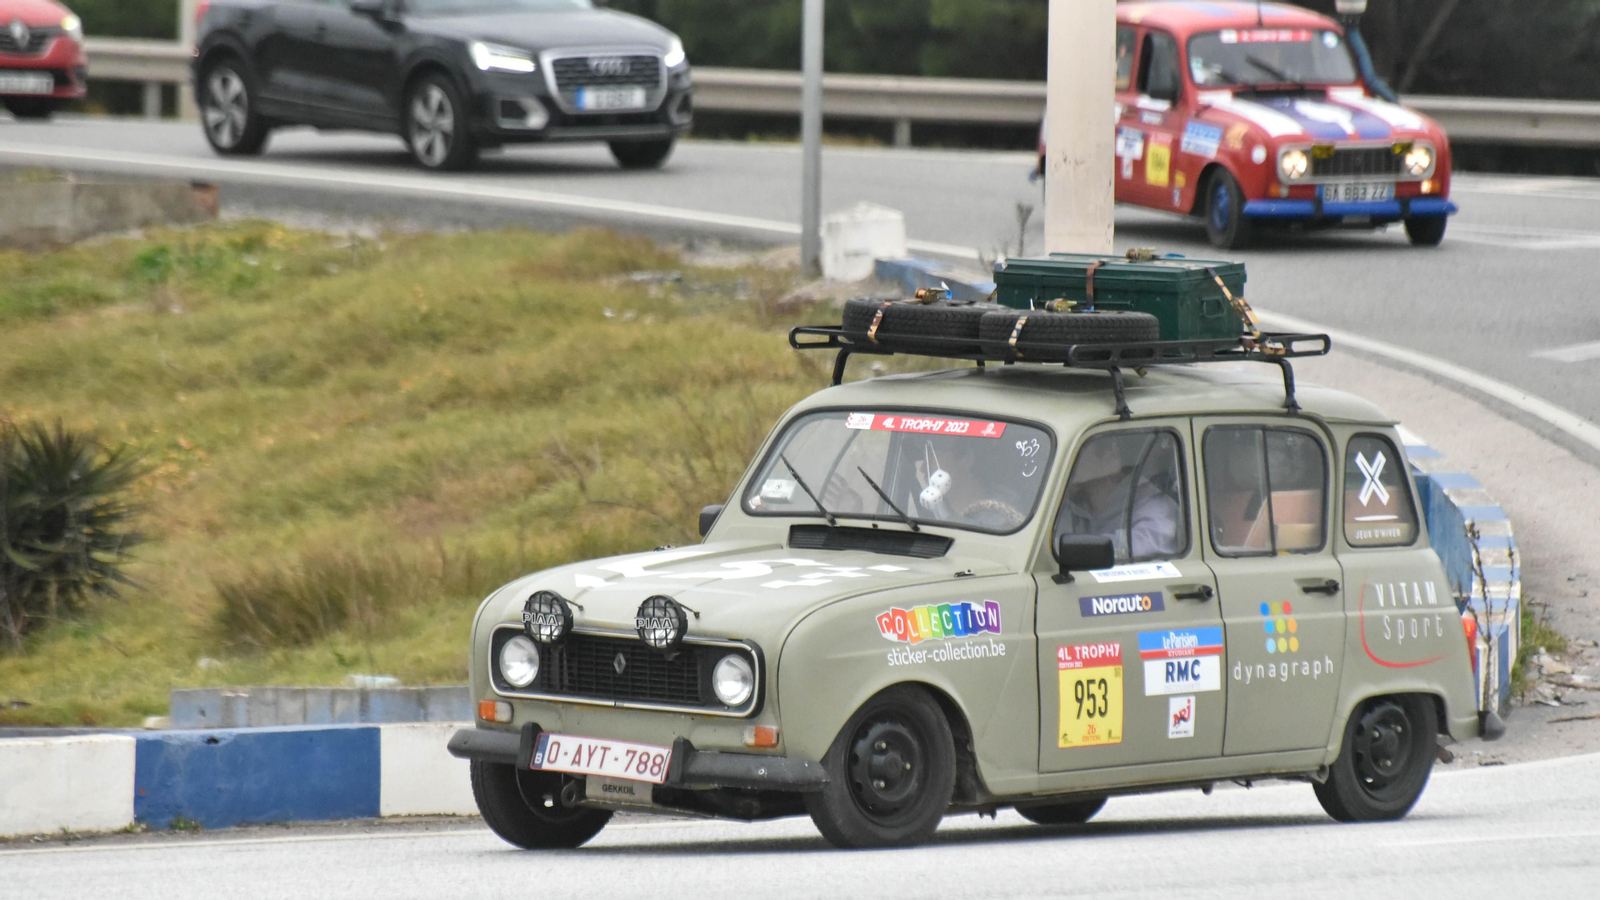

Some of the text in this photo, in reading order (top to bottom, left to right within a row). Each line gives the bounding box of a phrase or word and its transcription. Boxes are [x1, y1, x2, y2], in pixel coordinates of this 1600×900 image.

[882, 417, 896, 429] 4L
[900, 418, 945, 431] TROPHY
[944, 420, 969, 433] 2023
[1015, 438, 1040, 457] 953
[1355, 527, 1401, 539] JEUX D'HIVER
[1374, 581, 1438, 607] VITAM
[1091, 594, 1152, 614] Norauto
[521, 611, 558, 626] PIAA
[635, 616, 673, 630] PIAA
[880, 604, 999, 639] COLLECTION
[1382, 614, 1443, 645] Sport
[887, 639, 1006, 667] sticker-collection.be
[1058, 643, 1120, 661] 4L TROPHY
[1165, 659, 1200, 684] RMC
[1234, 655, 1334, 684] dynagraph
[1074, 678, 1108, 720] 953
[1087, 724, 1097, 735] 26
[534, 752, 543, 765] B
[602, 783, 636, 796] GEKKOIL
